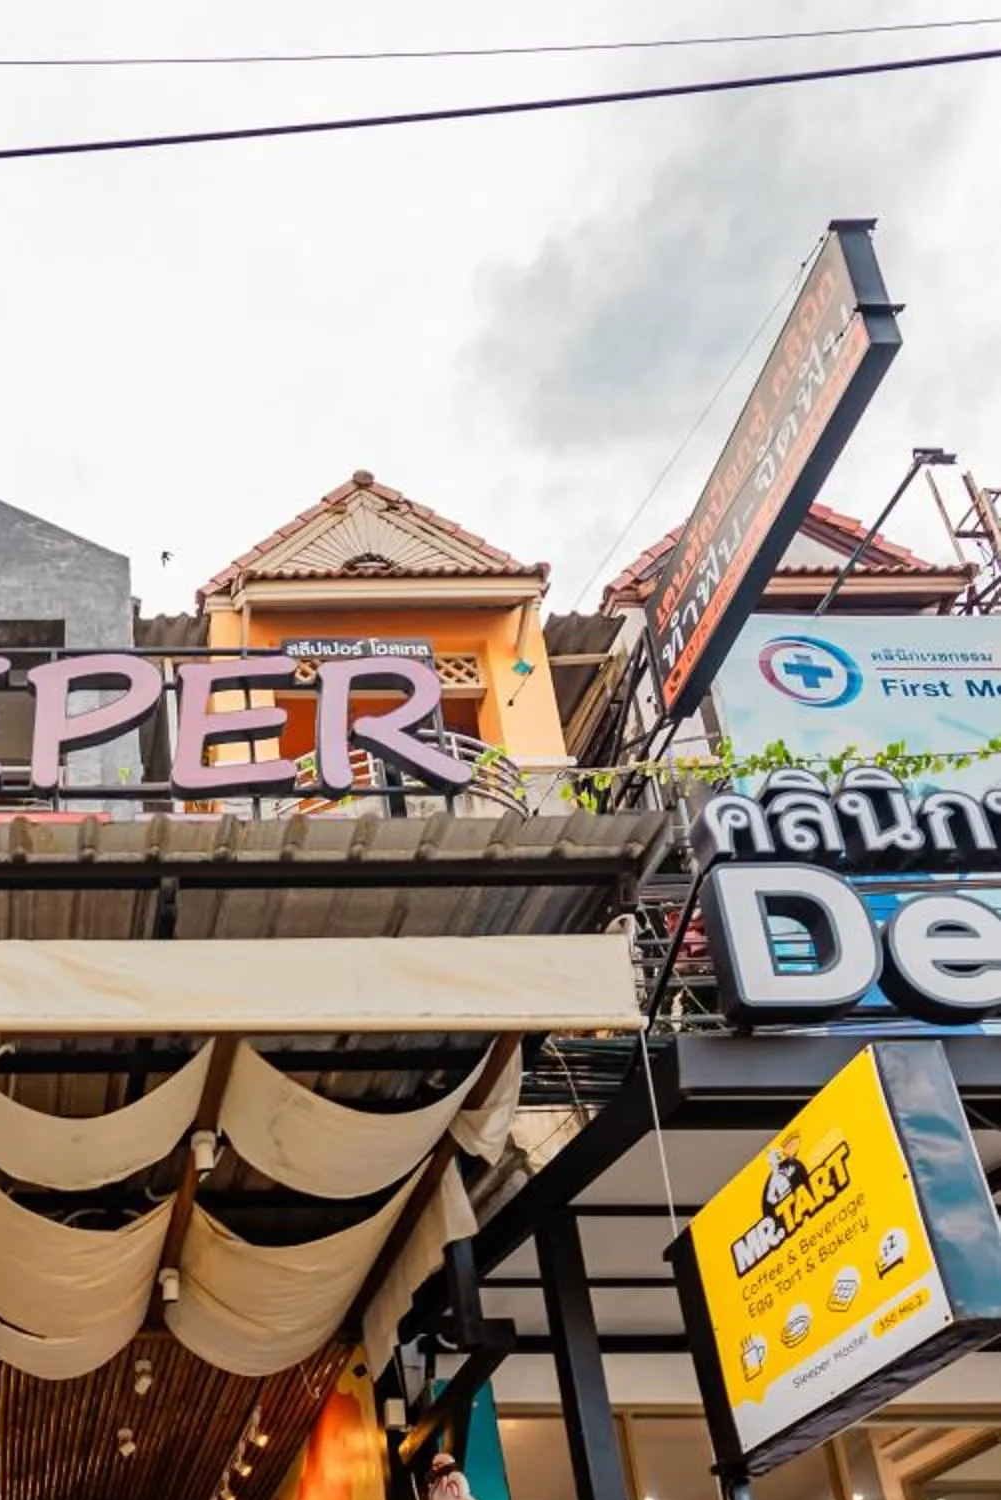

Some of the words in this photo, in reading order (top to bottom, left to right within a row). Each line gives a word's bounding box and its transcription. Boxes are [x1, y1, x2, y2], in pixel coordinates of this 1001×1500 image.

[881, 678, 952, 697] First
[965, 679, 1001, 697] M
[703, 766, 1001, 852] คลินิก
[709, 861, 1001, 1010] De
[742, 1257, 785, 1302] Coffee
[786, 1246, 798, 1266] &
[799, 1191, 866, 1257] Beverage
[775, 1265, 802, 1294] Tart
[805, 1255, 816, 1274] &
[818, 1212, 869, 1265] Bakery
